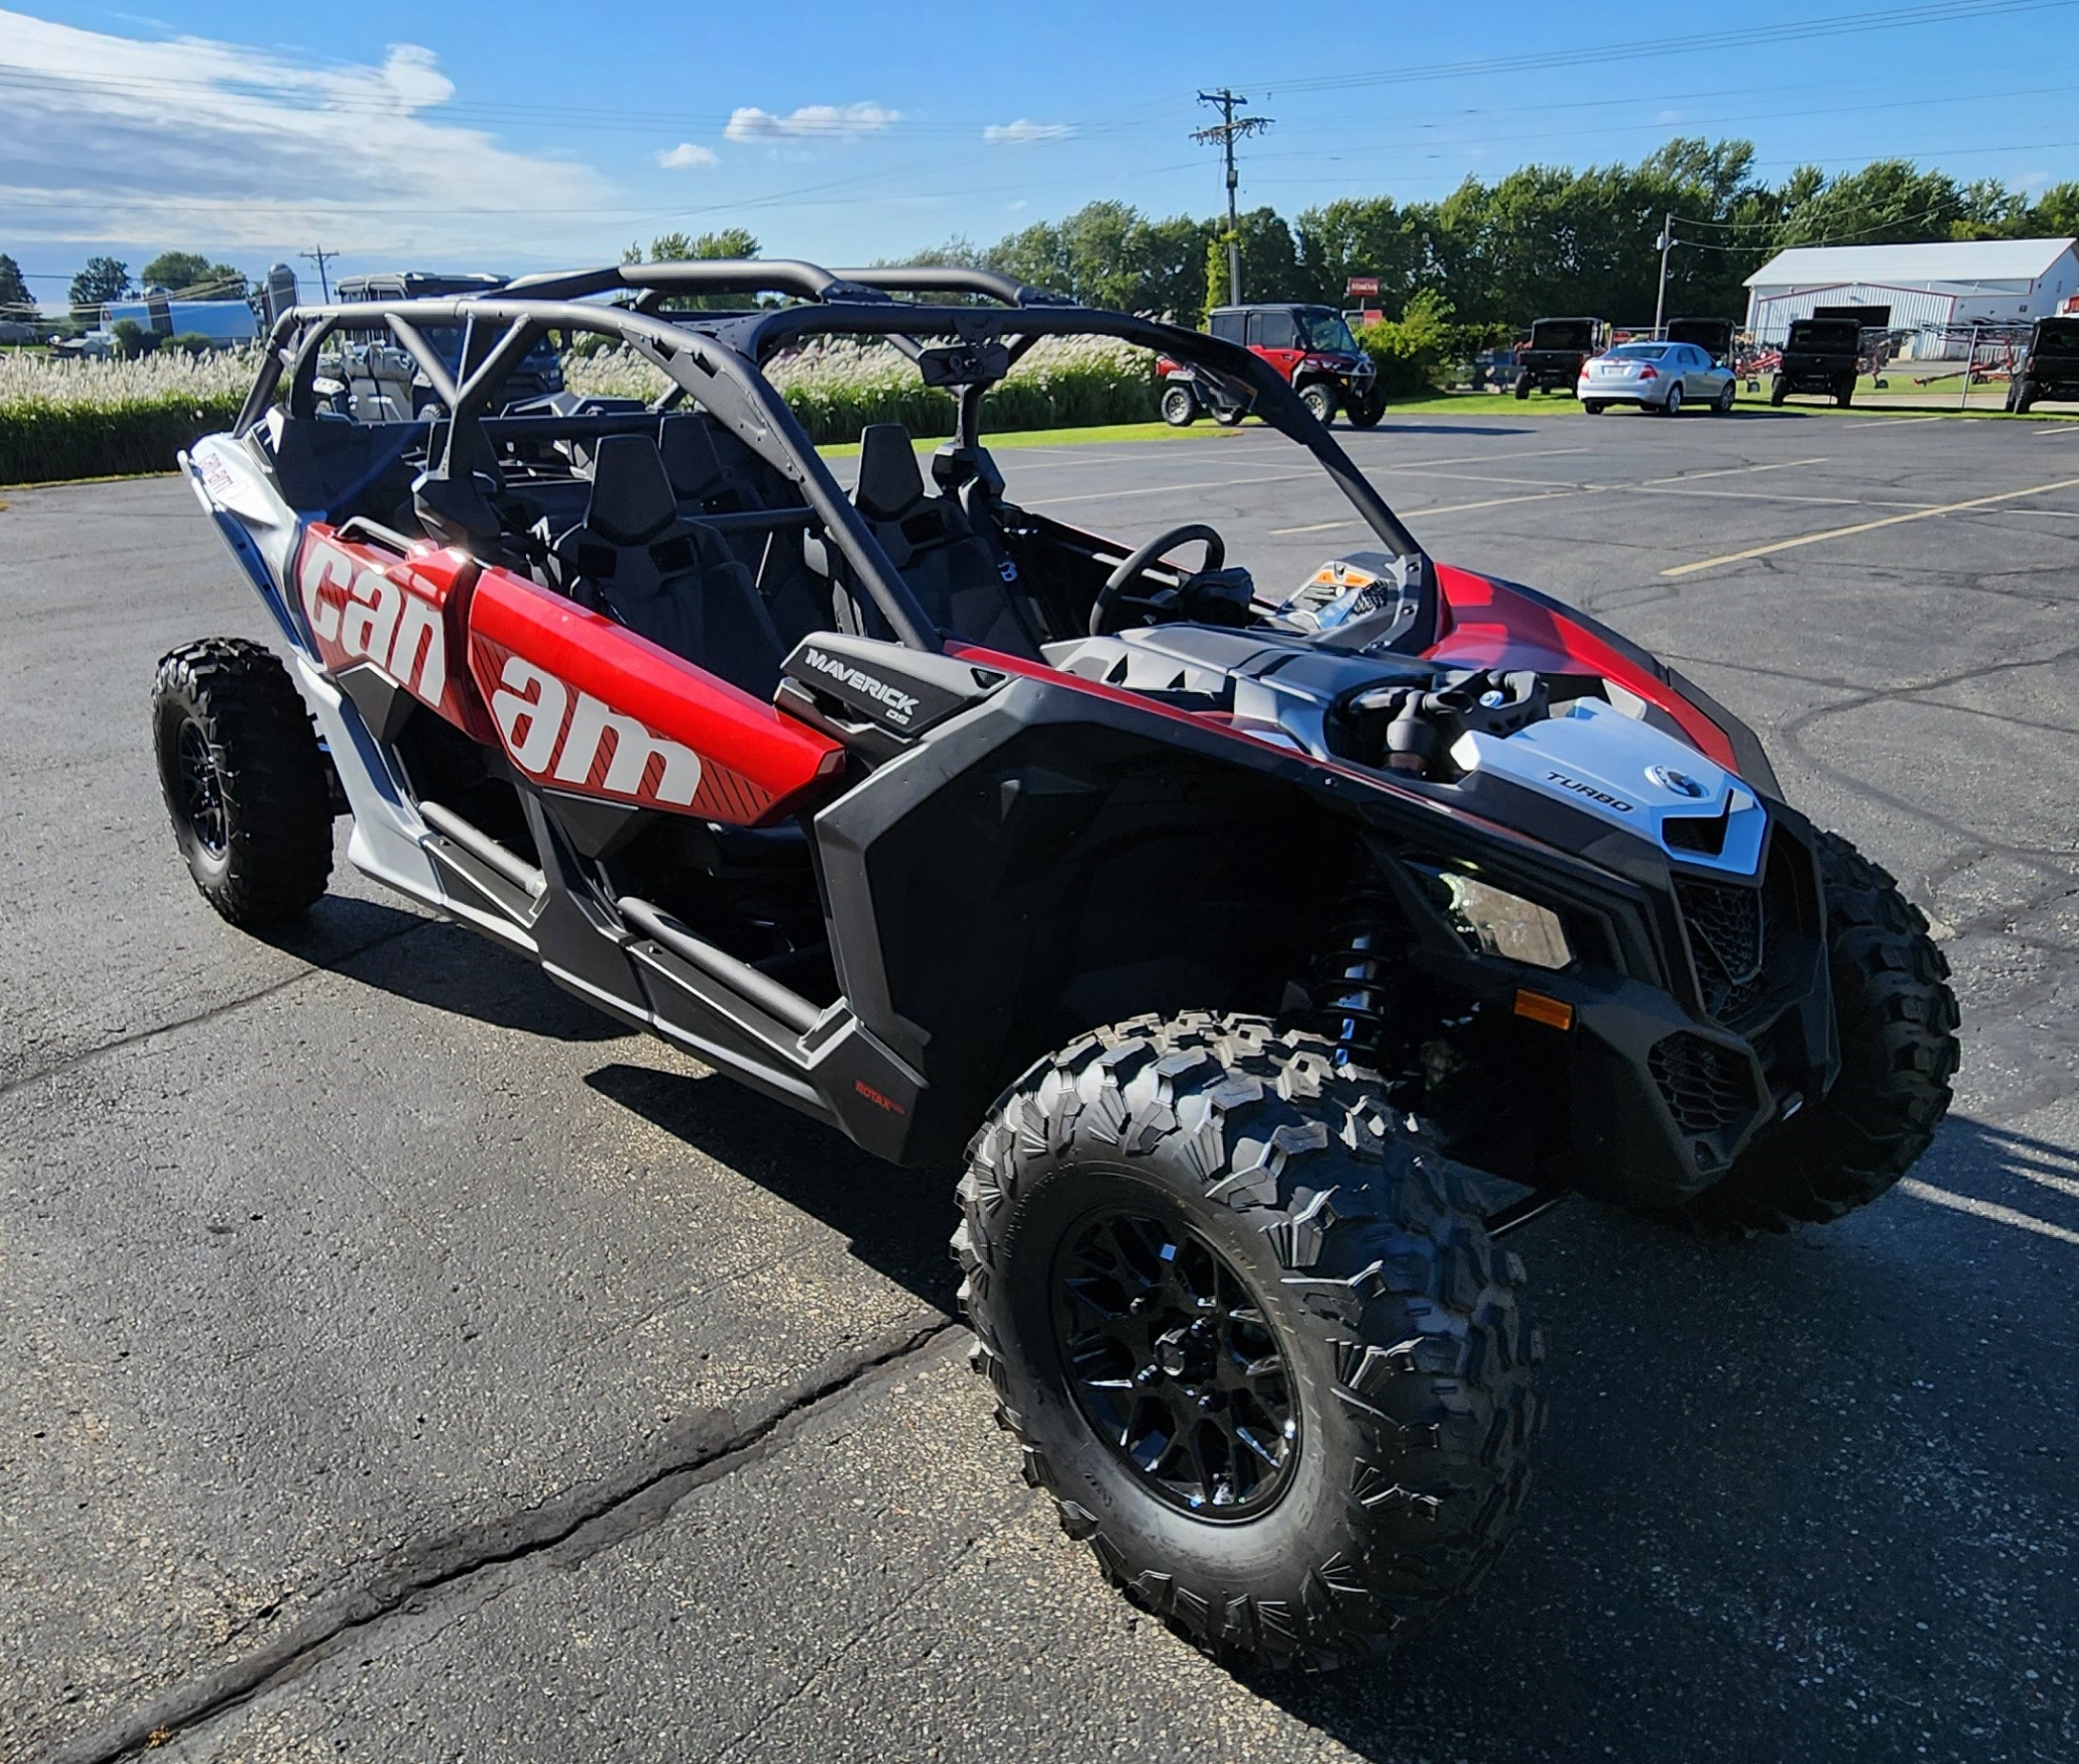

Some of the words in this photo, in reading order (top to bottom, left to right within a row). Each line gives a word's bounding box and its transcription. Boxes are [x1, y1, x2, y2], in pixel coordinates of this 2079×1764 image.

[302, 541, 446, 707] can
[492, 656, 702, 807] am
[804, 647, 920, 715] MAVERICK
[1546, 770, 1634, 812] TURBO
